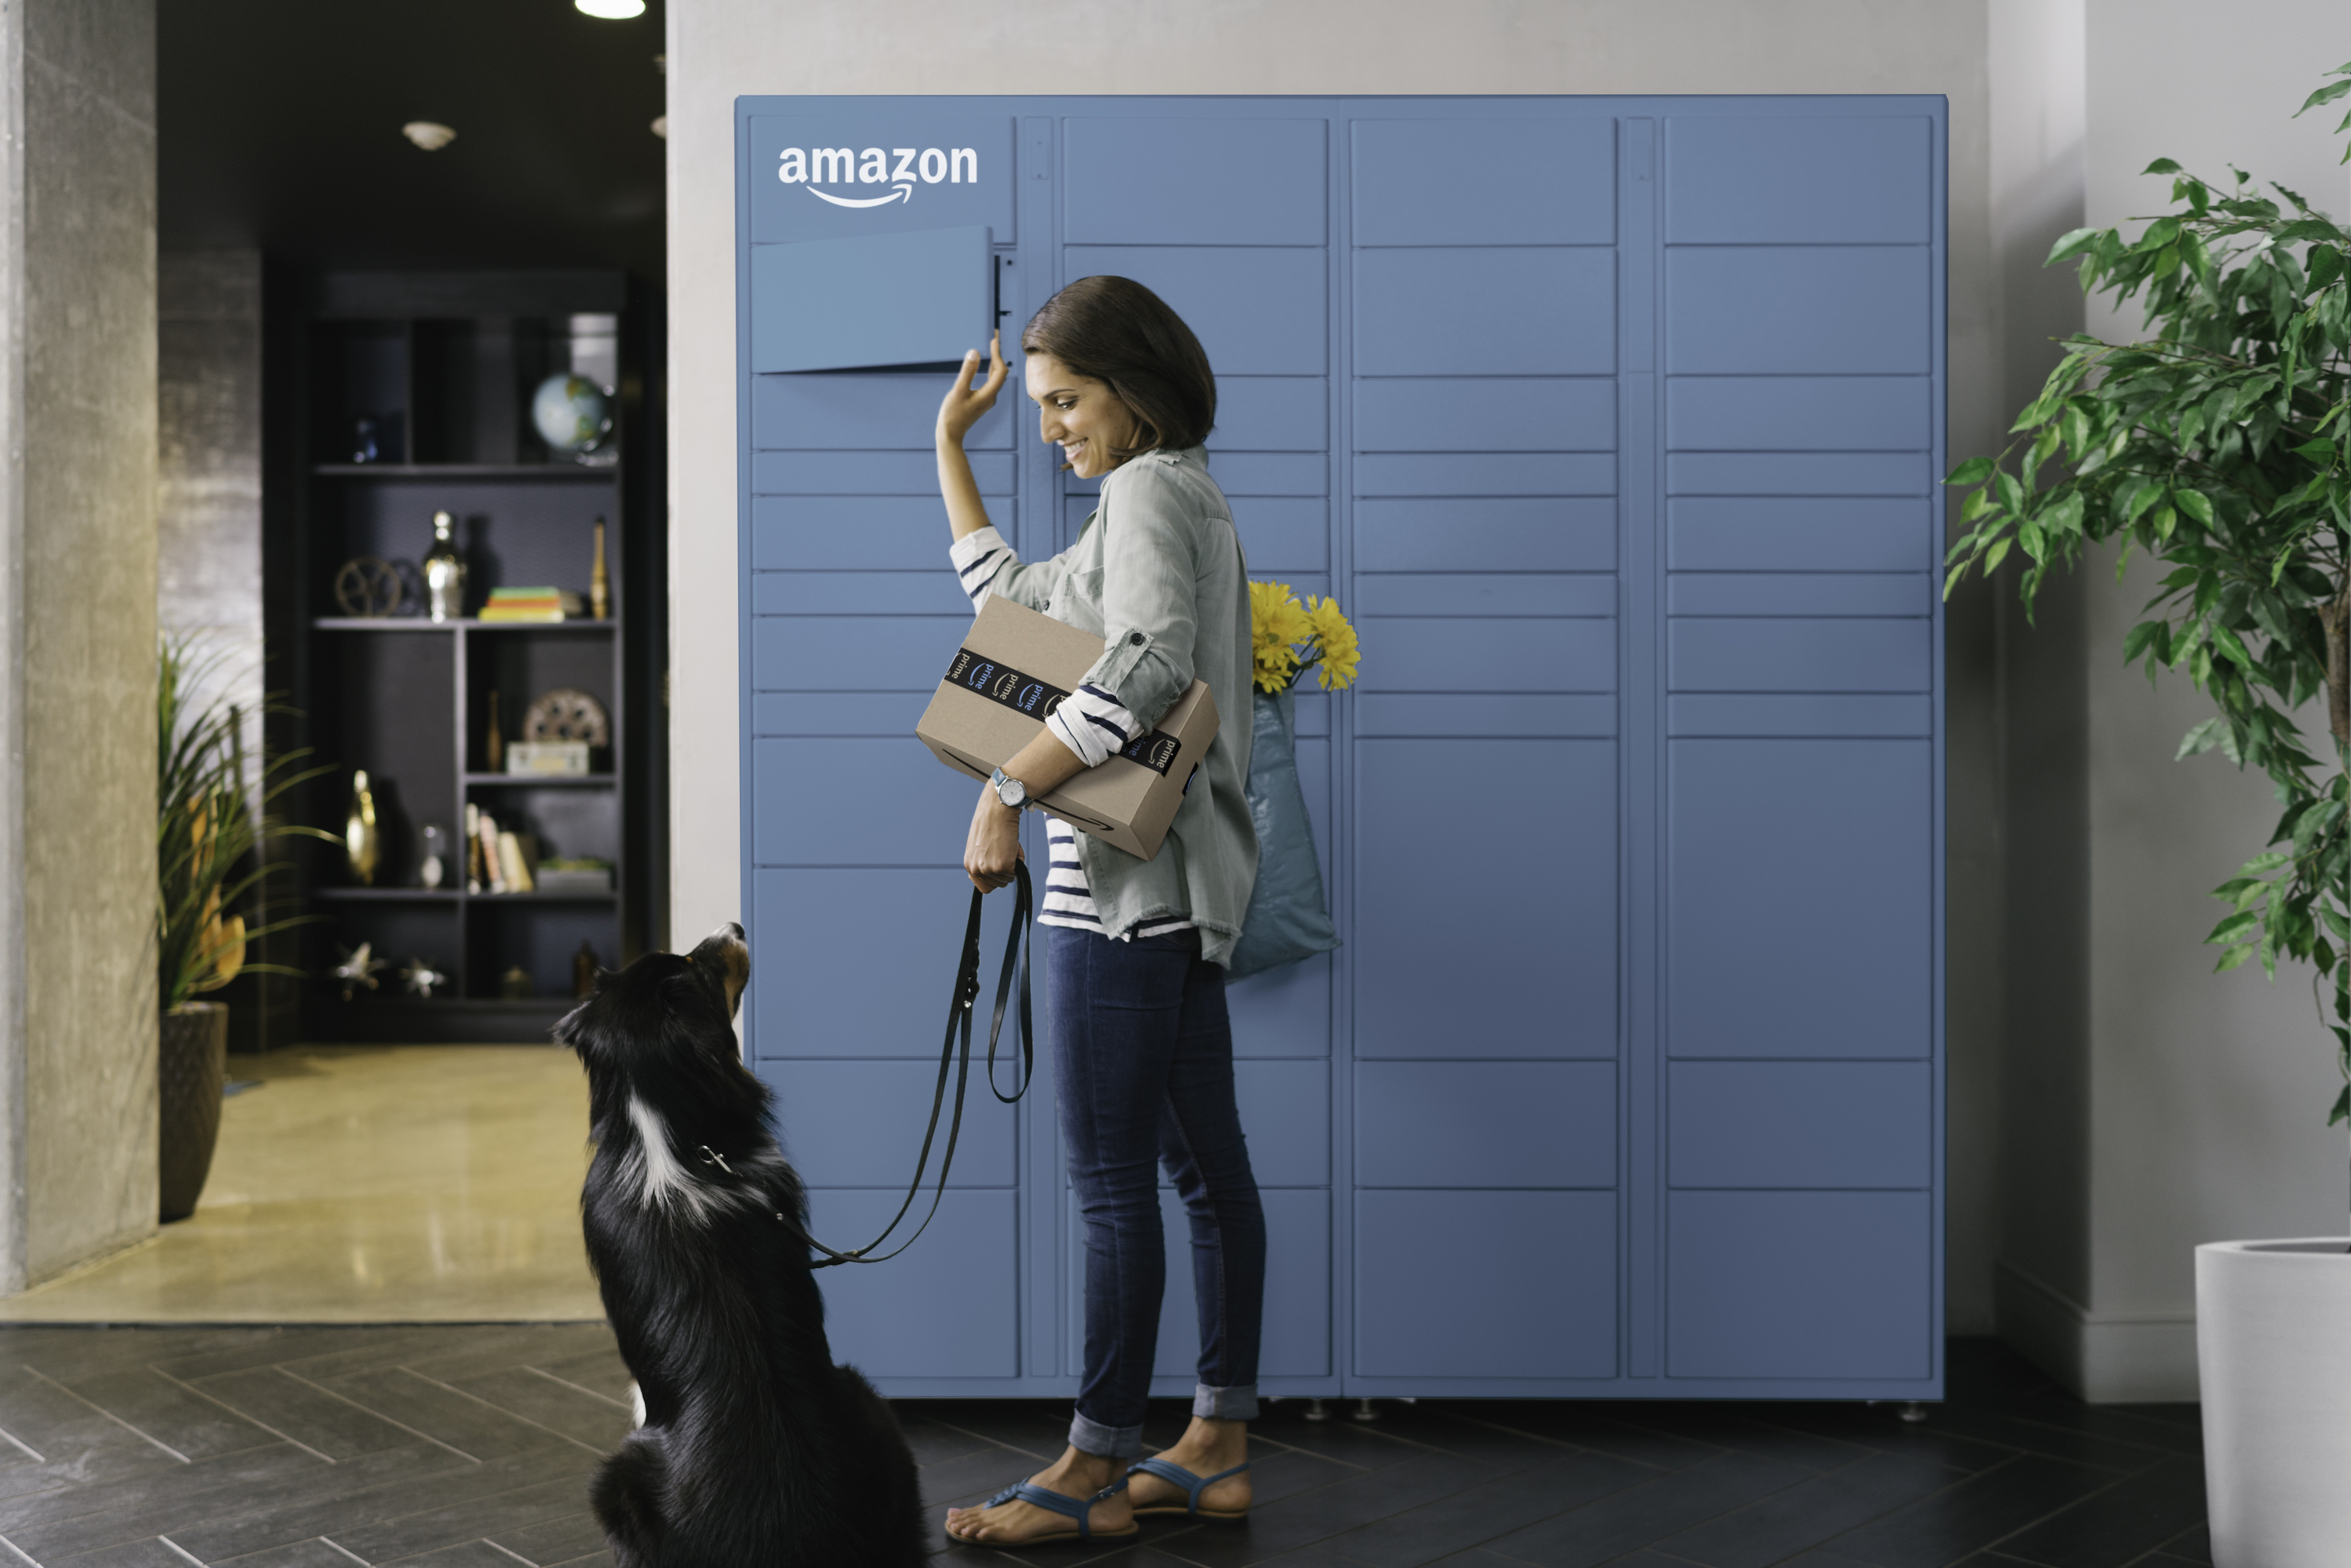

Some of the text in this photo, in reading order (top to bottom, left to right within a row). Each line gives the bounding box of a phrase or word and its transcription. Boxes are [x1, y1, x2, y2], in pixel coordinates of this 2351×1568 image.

[778, 147, 977, 184] amazon
[951, 653, 970, 679] prime
[975, 663, 994, 690] prime
[999, 674, 1019, 700] prime
[1024, 684, 1044, 711] prime
[1128, 736, 1147, 757] rime
[1156, 739, 1176, 768] prime
